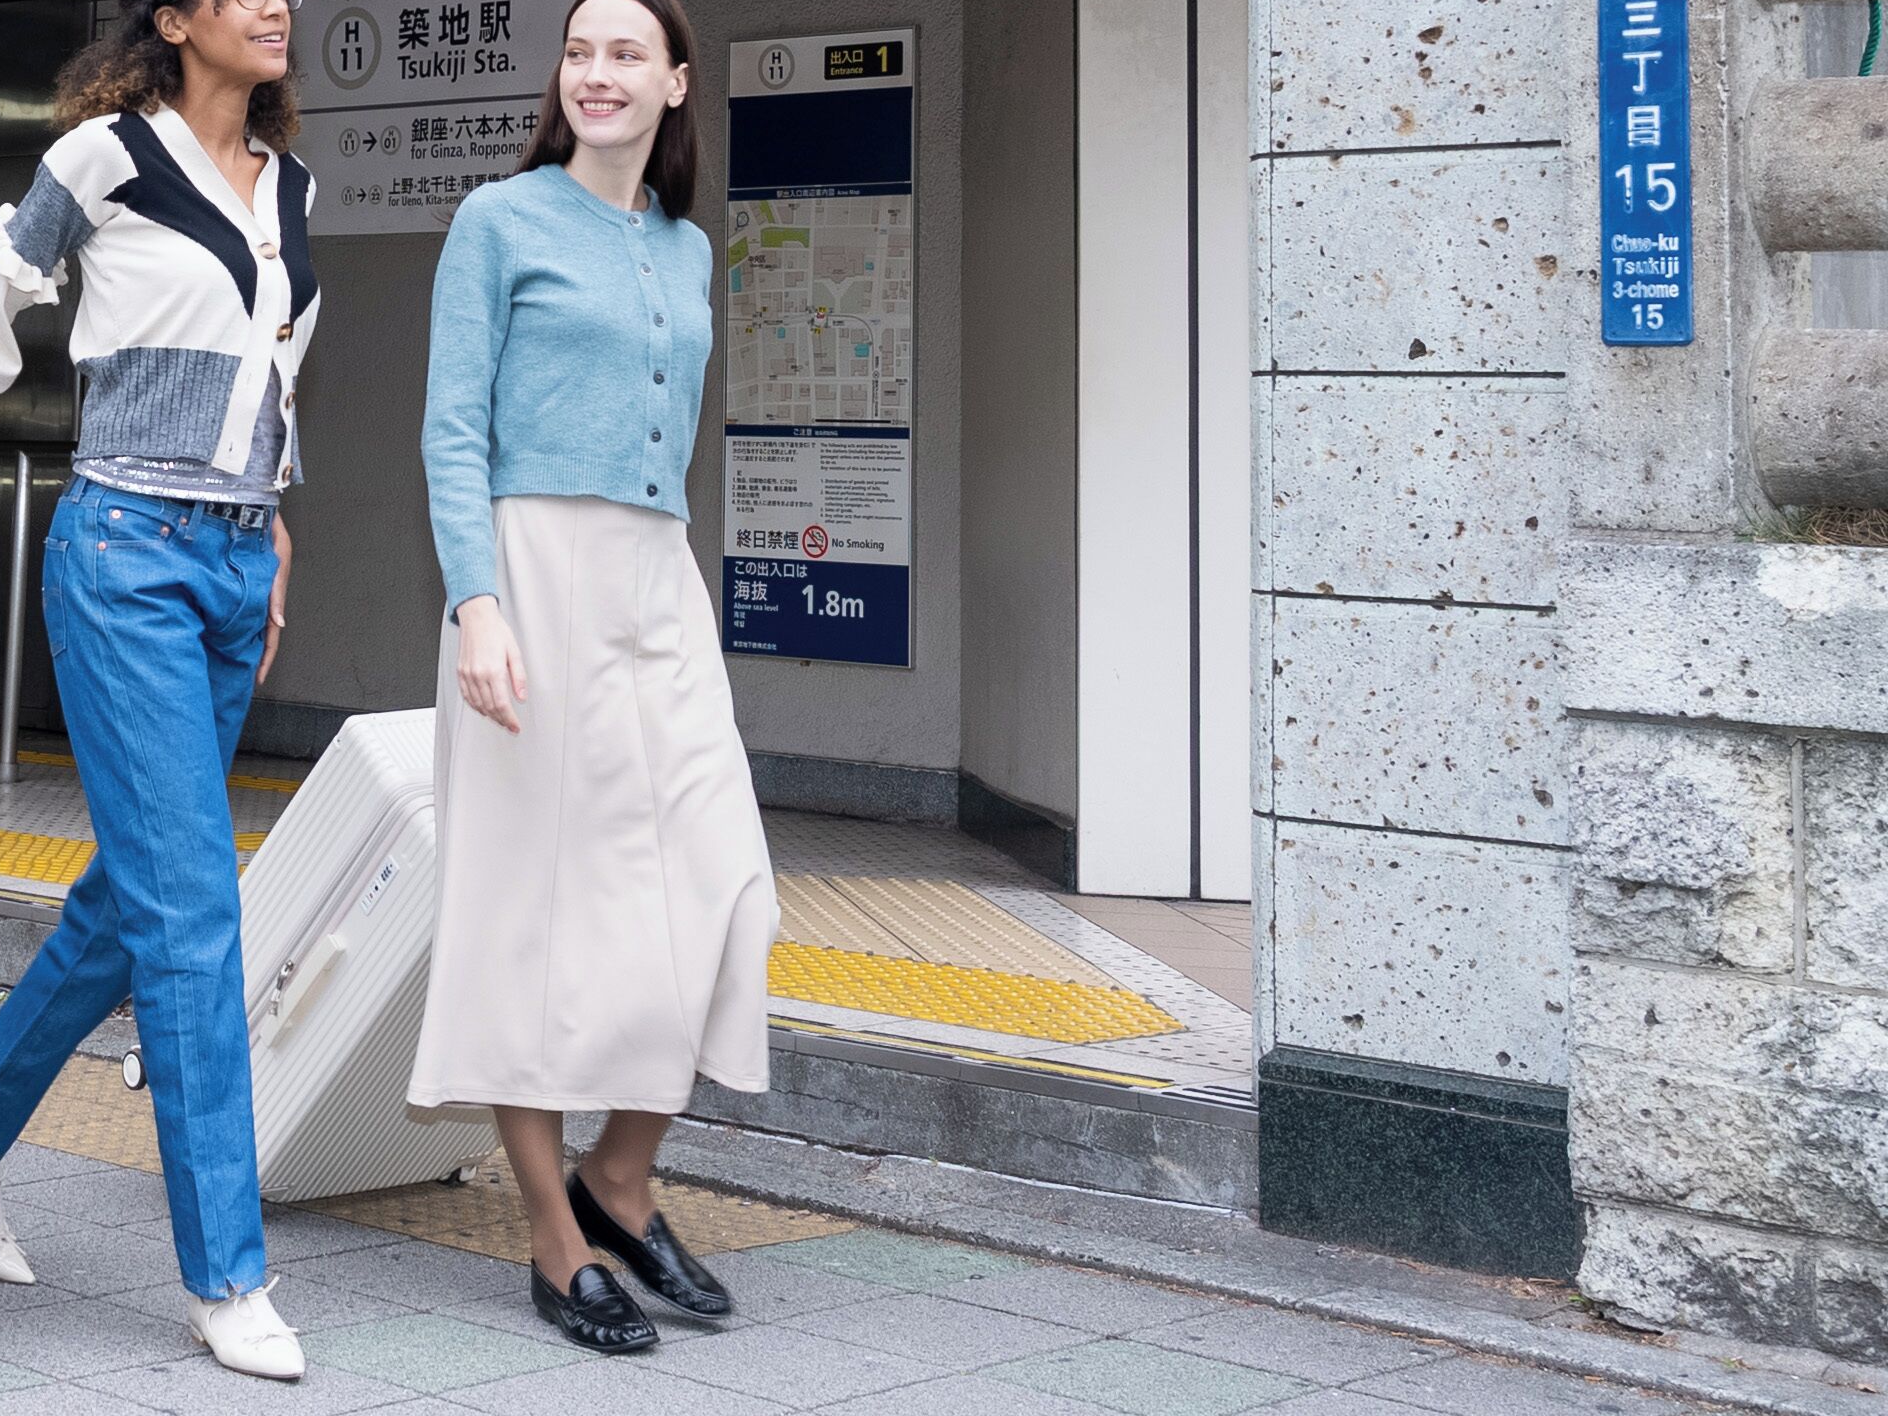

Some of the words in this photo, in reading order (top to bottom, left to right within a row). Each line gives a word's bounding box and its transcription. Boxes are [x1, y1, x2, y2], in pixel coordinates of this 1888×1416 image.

[345, 21, 359, 43] H
[398, 0, 511, 50] 築地駅
[340, 47, 362, 71] 11
[397, 50, 466, 83] Tsukiji
[474, 49, 516, 74] Sta.
[771, 51, 781, 64] H
[830, 49, 863, 65] 出入口
[877, 46, 888, 72] 1
[769, 66, 784, 80] 11
[830, 67, 863, 76] Entrance
[343, 140, 355, 152] 11
[383, 137, 396, 149] 01
[411, 144, 427, 160] for
[431, 142, 466, 159] Ginza,
[1615, 162, 1676, 213] 15
[388, 196, 400, 207] for
[402, 194, 423, 207] Ueno,
[1611, 233, 1679, 253] Chuo-ku
[1612, 257, 1680, 278] Tsukiji
[1612, 281, 1679, 298] 3-chome
[1632, 303, 1663, 330] 15
[736, 529, 799, 550] 終日禁煙
[832, 538, 844, 548] No
[847, 539, 885, 552] Smoking
[734, 561, 808, 578] この出入口は
[734, 580, 768, 601] 海抜
[802, 585, 864, 618] 1.8m
